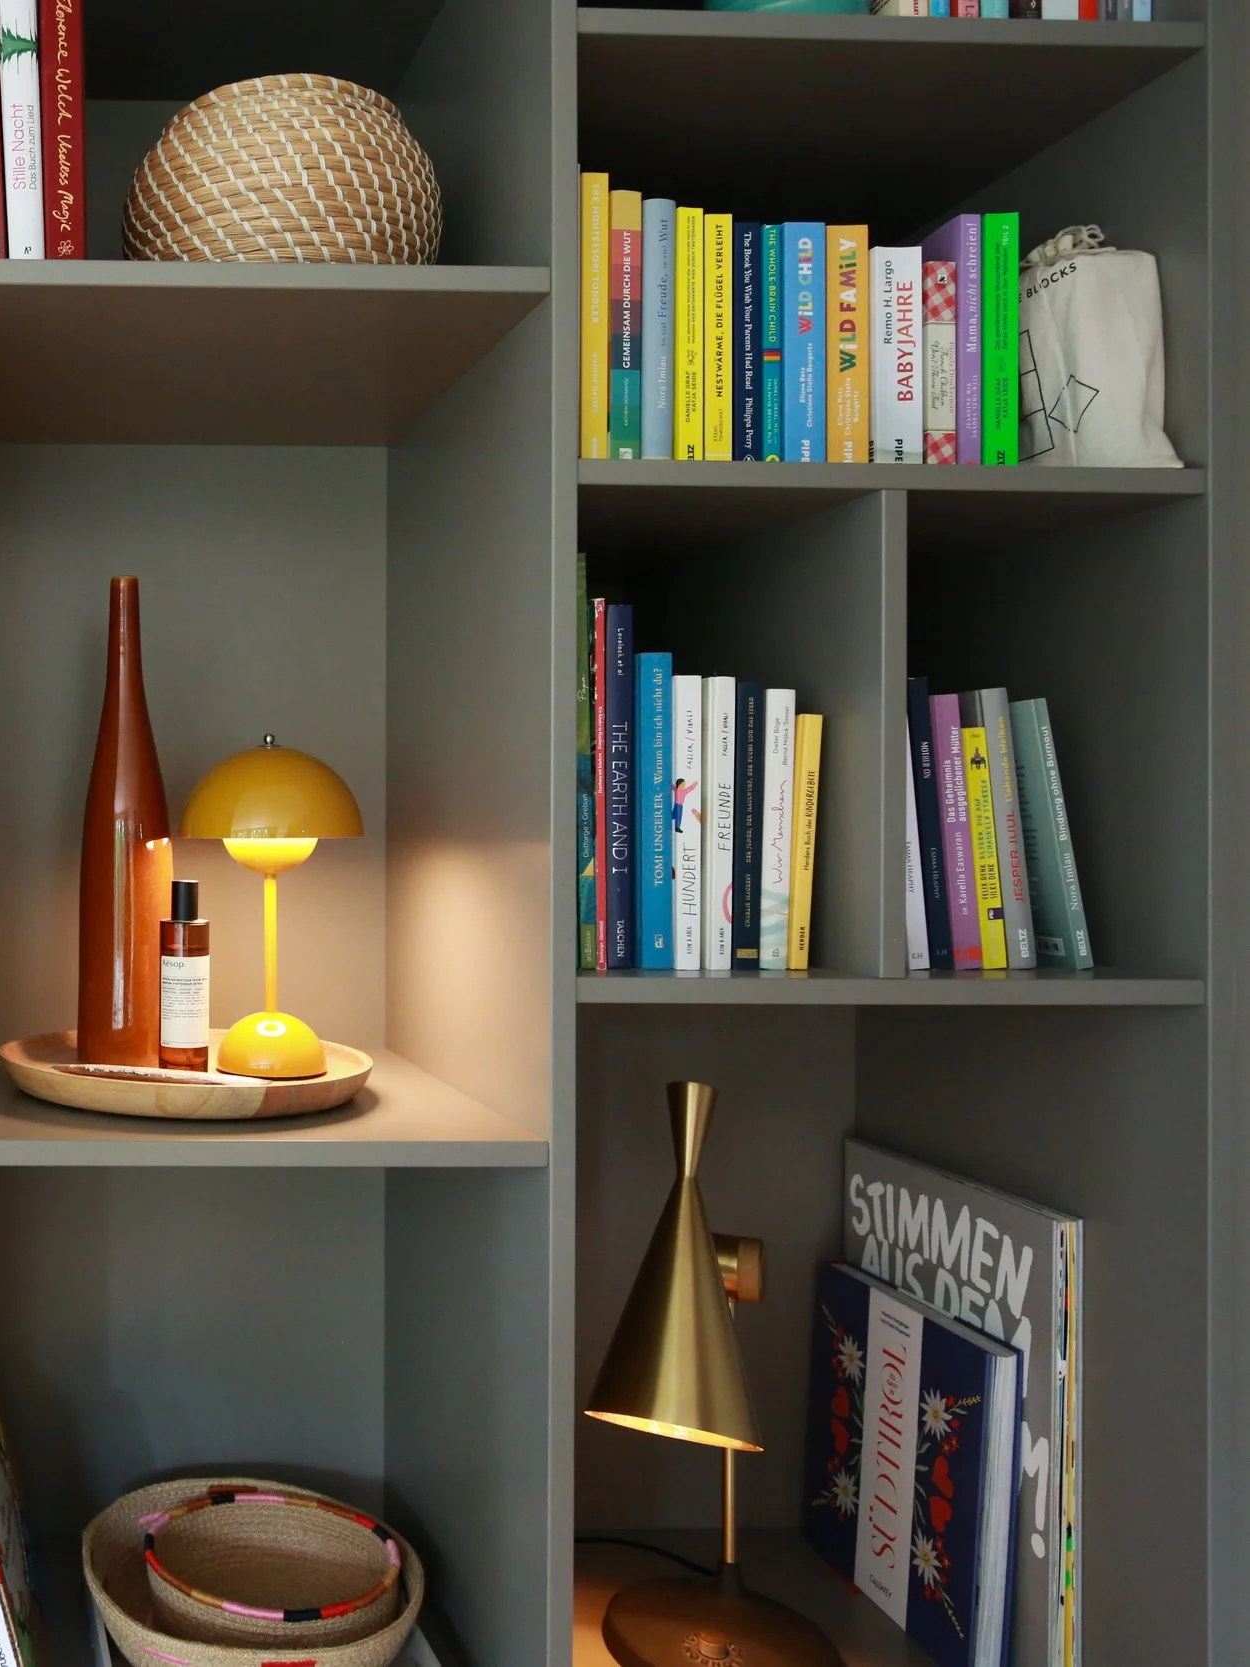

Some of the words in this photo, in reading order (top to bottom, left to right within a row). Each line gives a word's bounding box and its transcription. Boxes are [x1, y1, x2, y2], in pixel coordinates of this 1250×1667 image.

[55, 69, 72, 126] Welch
[10, 104, 25, 152] Nacht
[25, 105, 34, 124] Lied
[12, 156, 27, 190] Stille
[27, 147, 36, 170] Buch
[57, 135, 72, 186] Useless
[29, 173, 37, 190] Das
[53, 190, 74, 232] Magic
[622, 231, 631, 254] WUT
[658, 218, 668, 242] Wut
[744, 232, 752, 247] The
[769, 229, 777, 246] THE
[716, 224, 724, 269] VERLEIHT
[744, 248, 752, 268] Book
[966, 222, 978, 279] schreien!
[622, 256, 631, 272] DIE
[884, 260, 894, 293] Largo
[622, 274, 631, 308] DURCH
[714, 273, 724, 308] FLÜGEL
[744, 284, 752, 303] Wish
[768, 248, 777, 313] WHOLE-BRAIN
[884, 296, 892, 308] H.
[966, 282, 977, 312] nicht
[622, 310, 631, 369] GEMEINSAM
[745, 323, 753, 351] Parents
[768, 315, 776, 343] CHILD
[884, 312, 893, 344] Remo
[966, 315, 978, 352] Mama,
[657, 356, 667, 384] Imlau
[745, 353, 753, 368] Had
[745, 370, 753, 389] Read
[658, 386, 667, 409] Nora
[744, 398, 754, 427] Philippa
[743, 429, 753, 449] Perry
[653, 667, 663, 685] du?
[653, 687, 663, 712] nicht
[612, 721, 627, 753] THE
[653, 715, 663, 730] ich
[653, 732, 663, 748] bin
[951, 726, 961, 753] Mütter
[1042, 725, 1054, 767] Burnout
[654, 750, 663, 784] Warum
[945, 760, 955, 804] Geheimnis
[612, 760, 627, 816] EARTH
[955, 756, 967, 822] ausgeglichener
[1049, 769, 1060, 796] ohne
[654, 794, 663, 851] UNGERER
[717, 782, 731, 851] FREUNDE
[947, 805, 956, 822] Das
[1008, 810, 1018, 845] JUUL
[1054, 797, 1068, 841] Bindung
[612, 821, 627, 860] AND
[804, 829, 812, 845] Buch
[955, 832, 965, 871] Easwaran
[654, 855, 663, 886] TOMI
[683, 842, 697, 916] HUNDERT
[988, 864, 996, 880] DENK
[1011, 849, 1023, 903] JESPER
[1063, 852, 1075, 881] Imlau
[958, 874, 967, 904] Karella
[1069, 885, 1079, 911] Nora
[616, 919, 625, 957] TASCHEN
[1019, 928, 1029, 958] BELTZ
[850, 1174, 1033, 1318] STIMMEN
[868, 1344, 907, 1569] SÜDTIROL
